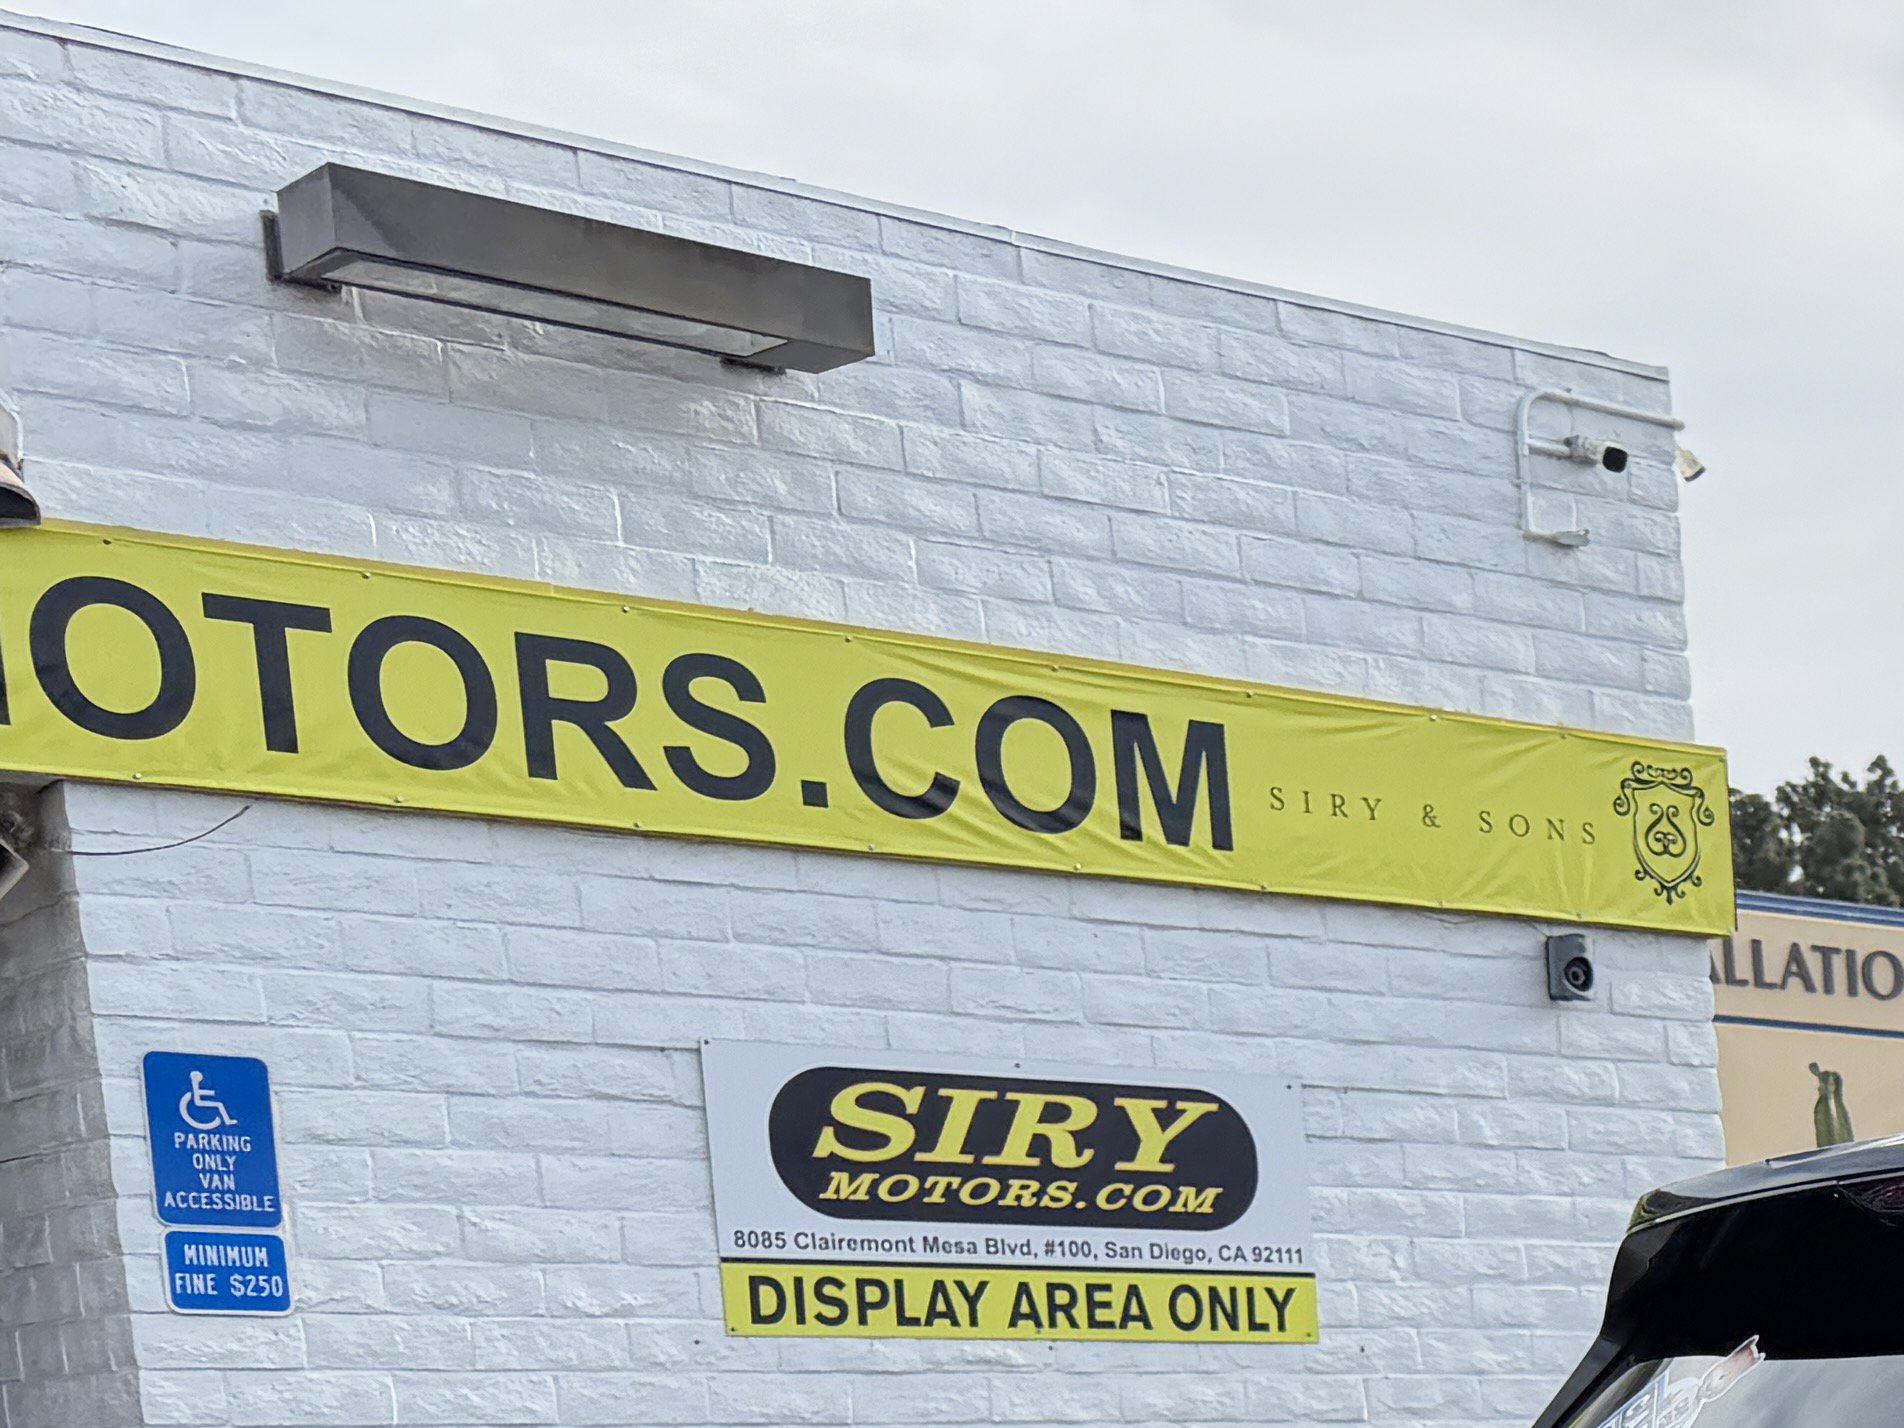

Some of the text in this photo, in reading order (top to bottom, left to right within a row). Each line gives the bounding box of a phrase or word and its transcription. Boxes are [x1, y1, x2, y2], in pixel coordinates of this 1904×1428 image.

[0, 576, 1235, 853] OTORS.COM
[1268, 785, 1599, 846] SIRY & SONS
[173, 1131, 252, 1153] PARKING
[810, 1081, 1222, 1174] SIRY
[192, 1152, 237, 1172] ONLY
[199, 1172, 236, 1191] VAN
[818, 1170, 1225, 1215] MOTORS.COM
[163, 1190, 276, 1213] ACCESSIBLE
[183, 1243, 269, 1268] MINIMUM
[733, 1229, 1305, 1266] 8085 Clairemont Mesa Blvd, #100, San Diego, CA 92111
[174, 1272, 284, 1298] FINE $250
[747, 1274, 1299, 1334] DISPLAY AREA ONLY
